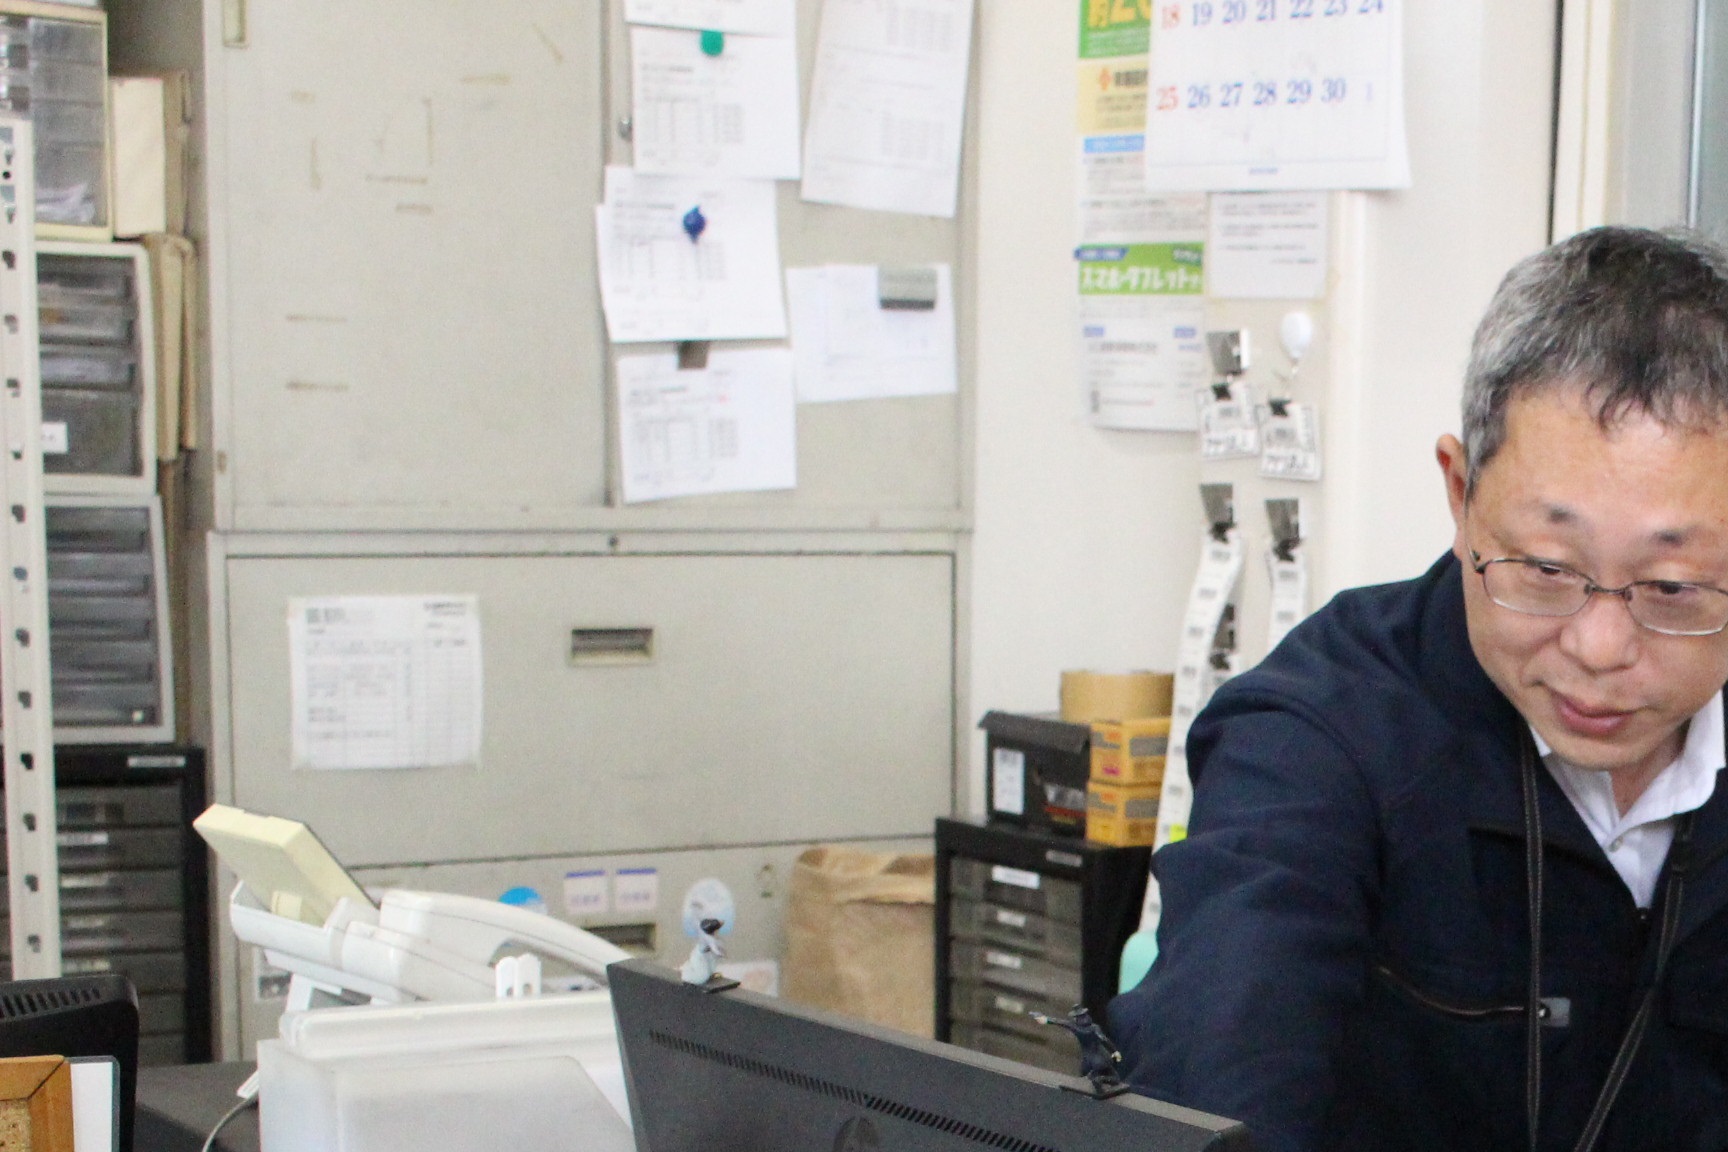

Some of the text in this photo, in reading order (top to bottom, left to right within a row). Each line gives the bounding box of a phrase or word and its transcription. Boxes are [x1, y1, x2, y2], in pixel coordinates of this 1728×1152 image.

[1162, 3, 1181, 30] 18
[1192, 2, 1213, 26] 19
[1222, 0, 1247, 24] 20
[1256, 0, 1277, 21] 21
[1290, 0, 1314, 18] 22
[1156, 85, 1179, 111] 25
[1187, 82, 1211, 109] 26
[1220, 81, 1244, 107] 27
[1253, 80, 1277, 106] 28
[1287, 78, 1312, 104] 29
[1320, 77, 1347, 103] 30
